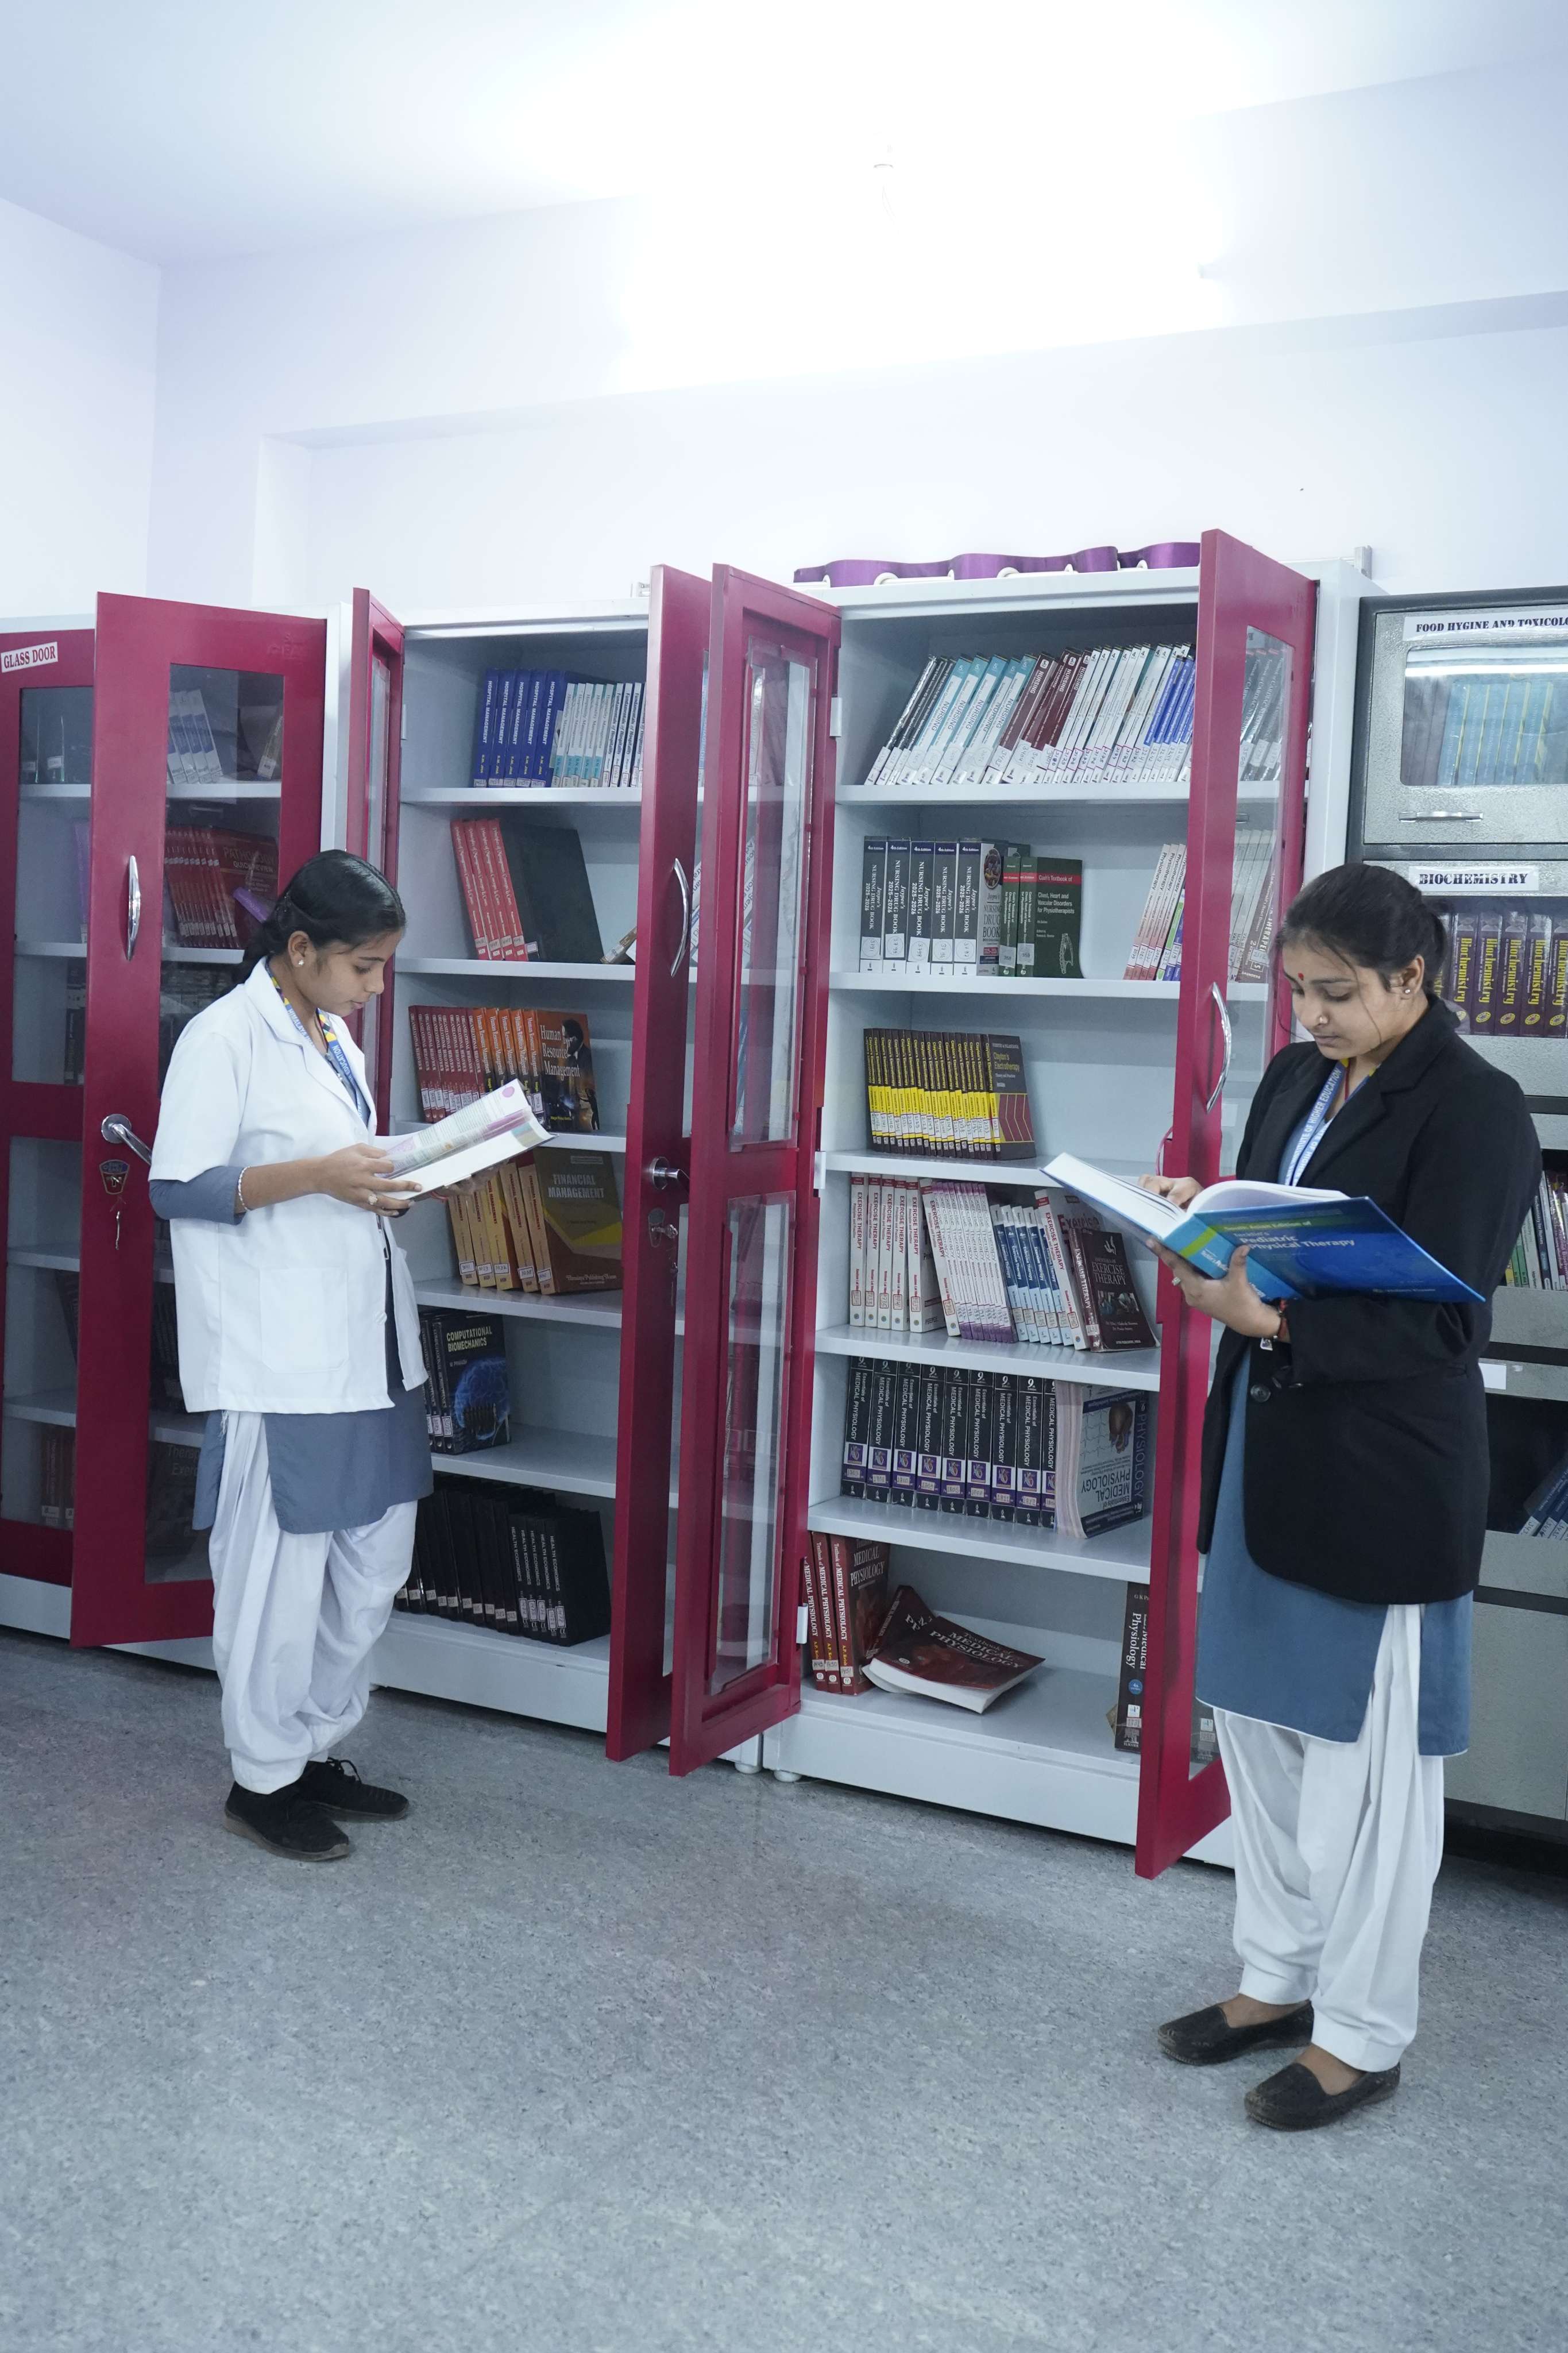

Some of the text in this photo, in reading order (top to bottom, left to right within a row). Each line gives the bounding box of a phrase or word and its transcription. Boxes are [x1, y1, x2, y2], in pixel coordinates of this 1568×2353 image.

[1416, 623, 1444, 632] FOOD
[1447, 621, 1489, 631] HYGINE
[1492, 620, 1514, 628] AND
[4, 646, 55, 668] GLASS DOOR
[1030, 671, 1044, 694] NURSING
[1059, 669, 1072, 692] NURSING
[1074, 667, 1086, 690] NURSING
[543, 708, 551, 745] MANAGEMENT
[932, 701, 949, 731] NURSING
[948, 700, 965, 730] NURSING
[966, 700, 984, 730] NURSING
[996, 699, 1014, 728] NURSING
[1152, 853, 1167, 890] Physiotherapy
[1160, 853, 1175, 890] Physiotherapy
[1168, 854, 1181, 891] Physiotherapy
[1419, 873, 1528, 884] BIOCHEMISTRY
[1454, 938, 1472, 1002] Biochemistry
[1479, 938, 1497, 1003] Biochemistry
[1503, 939, 1521, 1004] Biochemistry
[1528, 940, 1546, 1005] Biochemistry
[1552, 940, 1568, 1005] Biochemistry
[540, 1025, 561, 1040] Human
[333, 1045, 350, 1075] EDUCATION
[543, 1043, 567, 1058] Resource
[994, 1052, 1009, 1060] Clayton's
[544, 1061, 580, 1081] Management
[994, 1062, 1020, 1071] Electrotherapy
[1307, 1067, 1342, 1135] OF HIGHER EDUCATION
[548, 1188, 604, 1198] MANAGEMENT
[553, 1174, 595, 1185] FINANCIAL
[930, 1200, 945, 1257] EXERCISE THERAPY
[1045, 1212, 1064, 1270] EXERCISE THERAPY
[1241, 1235, 1299, 1243] Pediatric
[1249, 1239, 1355, 1250] Physical Therapy
[1075, 1248, 1091, 1309] EXERCISE THERAPY
[1092, 1263, 1125, 1276] EXERCISE
[1094, 1273, 1126, 1285] THERAPY
[447, 1326, 492, 1341] COMPUTATIONAL
[448, 1337, 487, 1352] BIOMECHANICS
[1134, 1414, 1148, 1498] PHYSIOLOGY
[1082, 1468, 1130, 1493] PHYSIOLOGY
[1096, 1483, 1130, 1502] MEDICAL
[854, 1546, 879, 1567] MEDICAL
[851, 1561, 885, 1587] PHYSIOLOGY
[804, 1564, 818, 1636] MEDICAL PHYSIOLOGY
[819, 1566, 832, 1639] MEDICAL PHYSIOLOGY
[839, 1599, 847, 1641] PHYSIOLOGY
[929, 1631, 1025, 1668] PHYSIOLOGY
[948, 1633, 1015, 1661] MEDICAL
[1126, 1613, 1141, 1668] Physiology
